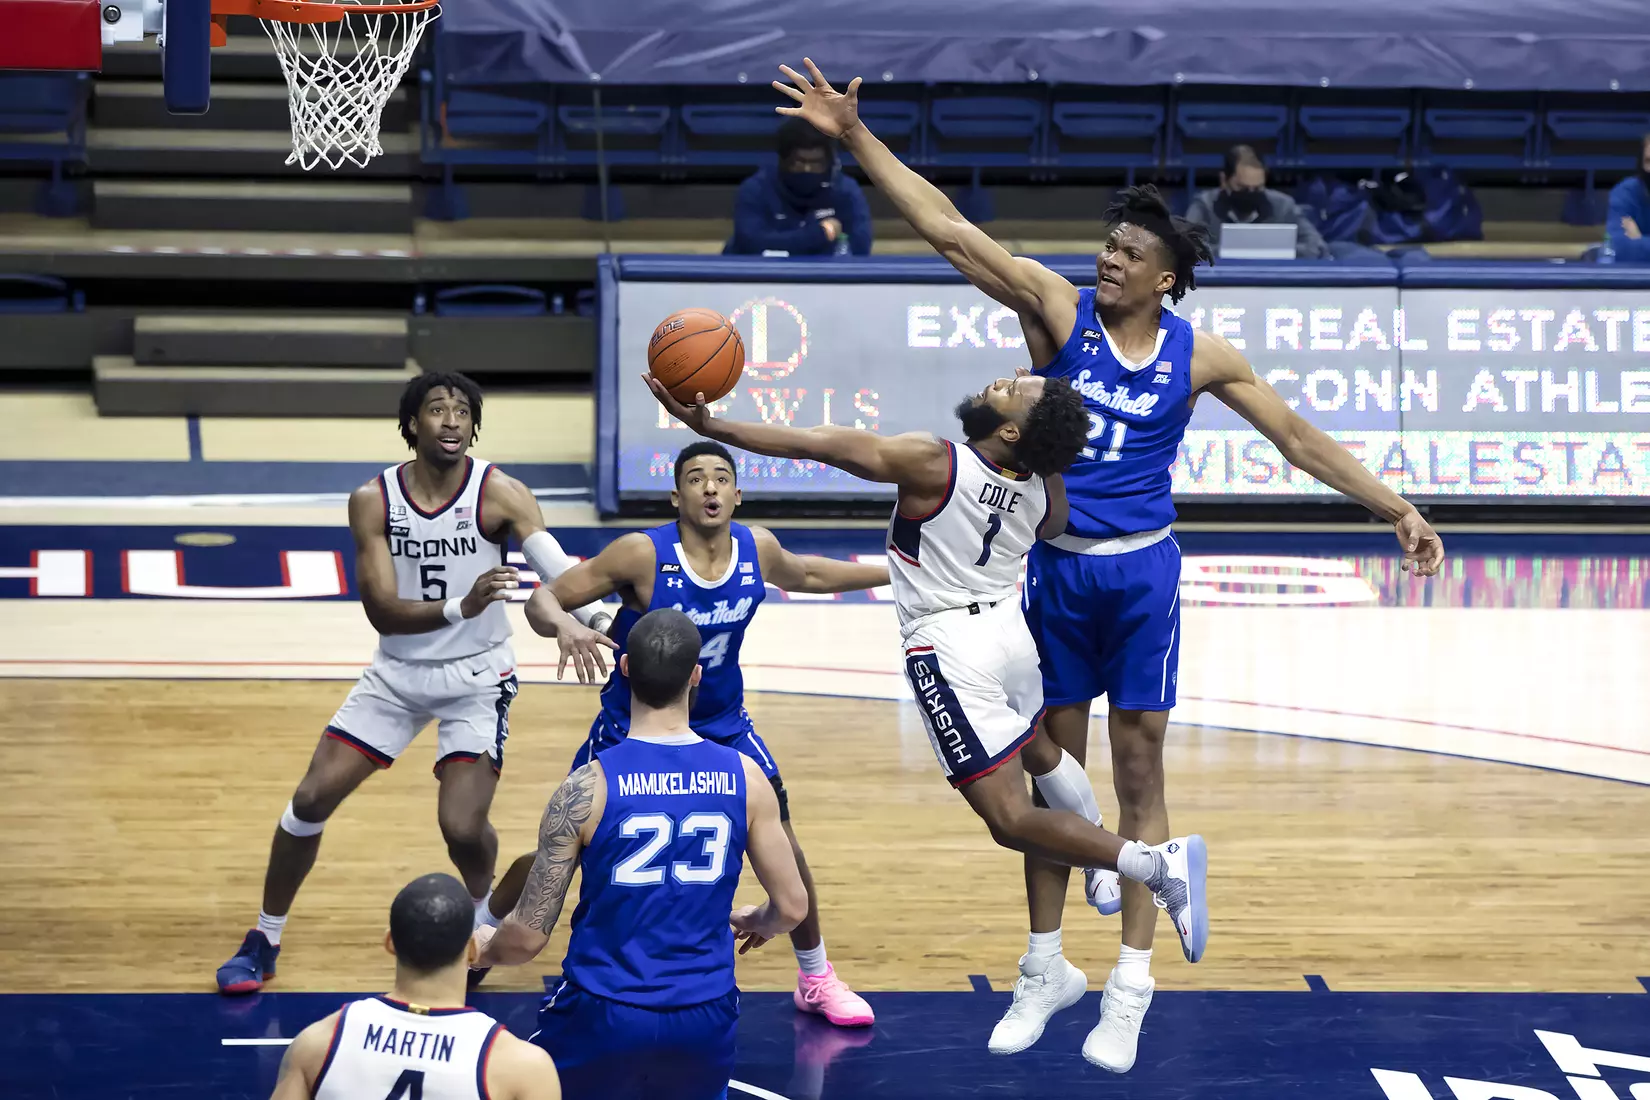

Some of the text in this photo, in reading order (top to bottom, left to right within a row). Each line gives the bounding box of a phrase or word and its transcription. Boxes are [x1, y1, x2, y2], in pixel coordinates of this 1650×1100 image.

[1266, 307, 1428, 351] REAL
[1107, 384, 1159, 417] Hall
[1252, 368, 1438, 412] CONN
[1077, 411, 1128, 462] 21
[978, 482, 1023, 514] COLE
[390, 537, 476, 559] UCONN
[974, 513, 1002, 567] 1
[420, 564, 447, 601] 5
[698, 631, 732, 670] 4
[914, 660, 972, 764] HUSKIES
[618, 771, 737, 797] MAMUKELASHVILI
[611, 811, 732, 887] 23
[363, 1023, 455, 1062] MARTIN
